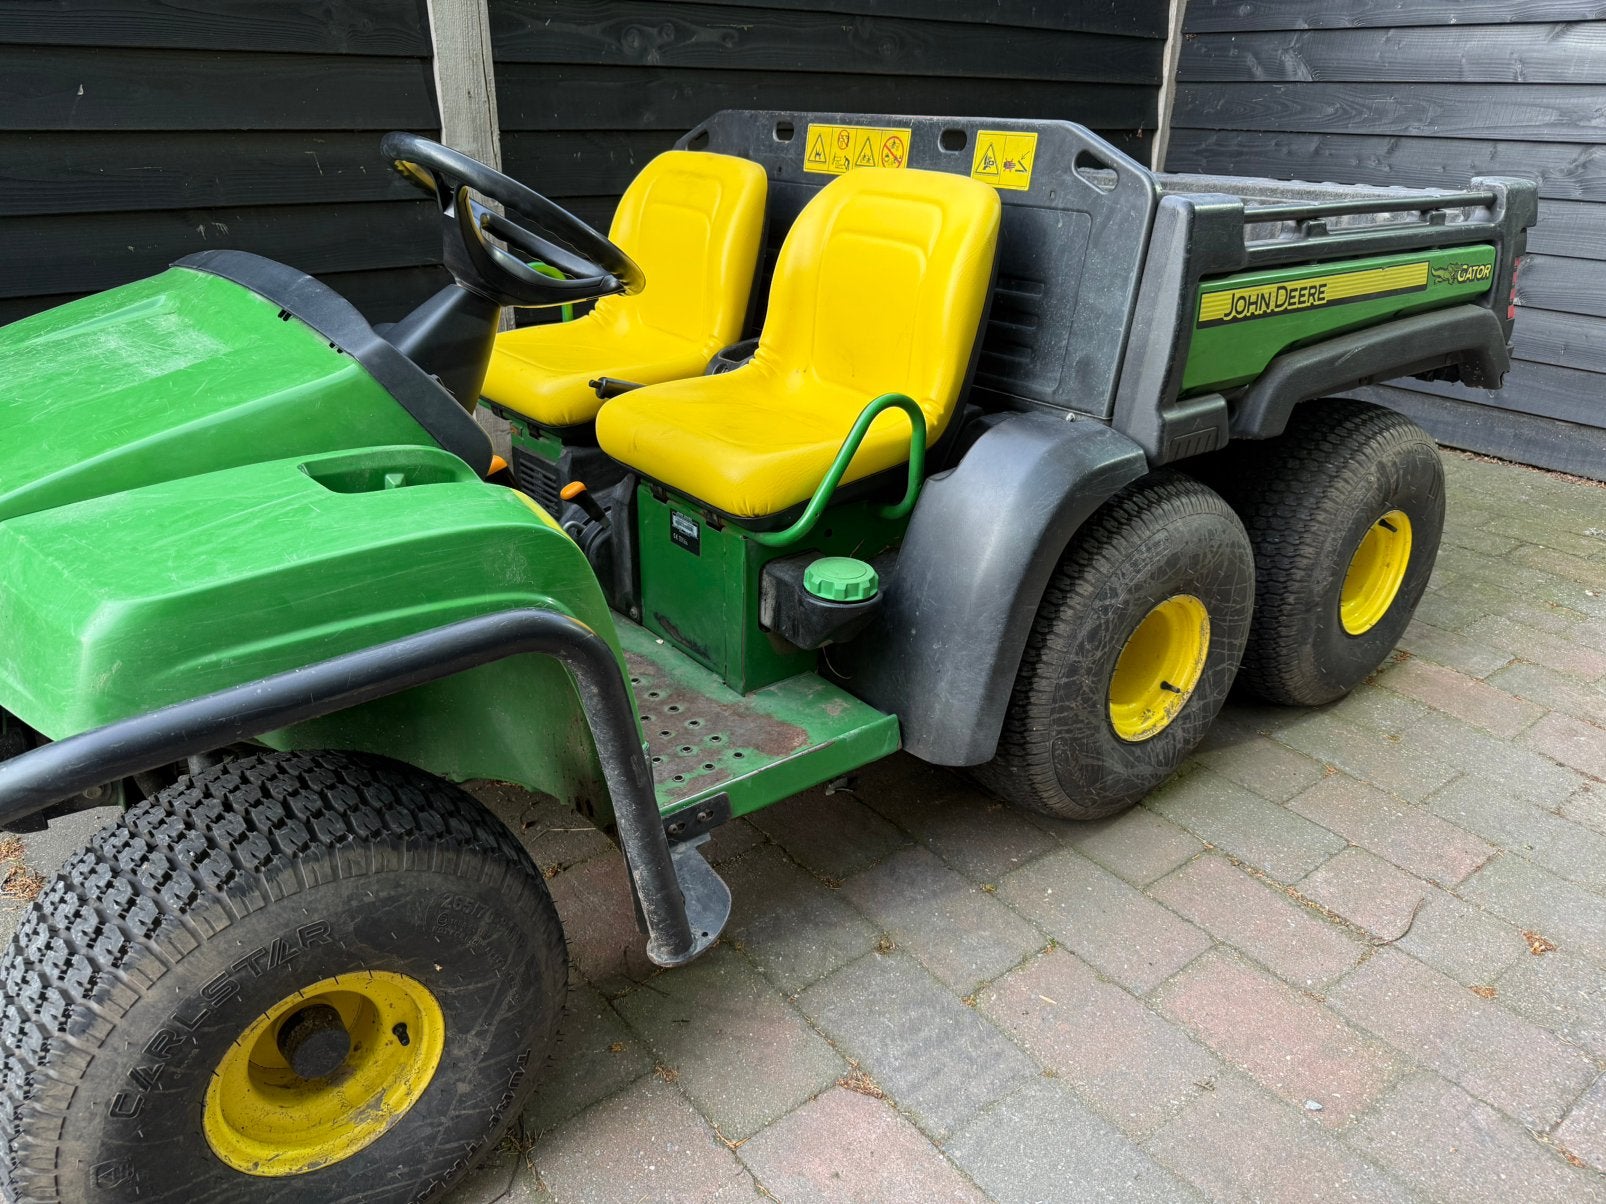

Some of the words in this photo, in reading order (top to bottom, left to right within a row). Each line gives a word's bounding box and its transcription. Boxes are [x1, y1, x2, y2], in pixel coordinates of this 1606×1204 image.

[1457, 264, 1492, 283] GATOR
[1223, 292, 1272, 318] JOHN
[1275, 283, 1328, 309] DEERE
[109, 919, 334, 1119] CARLSTAR
